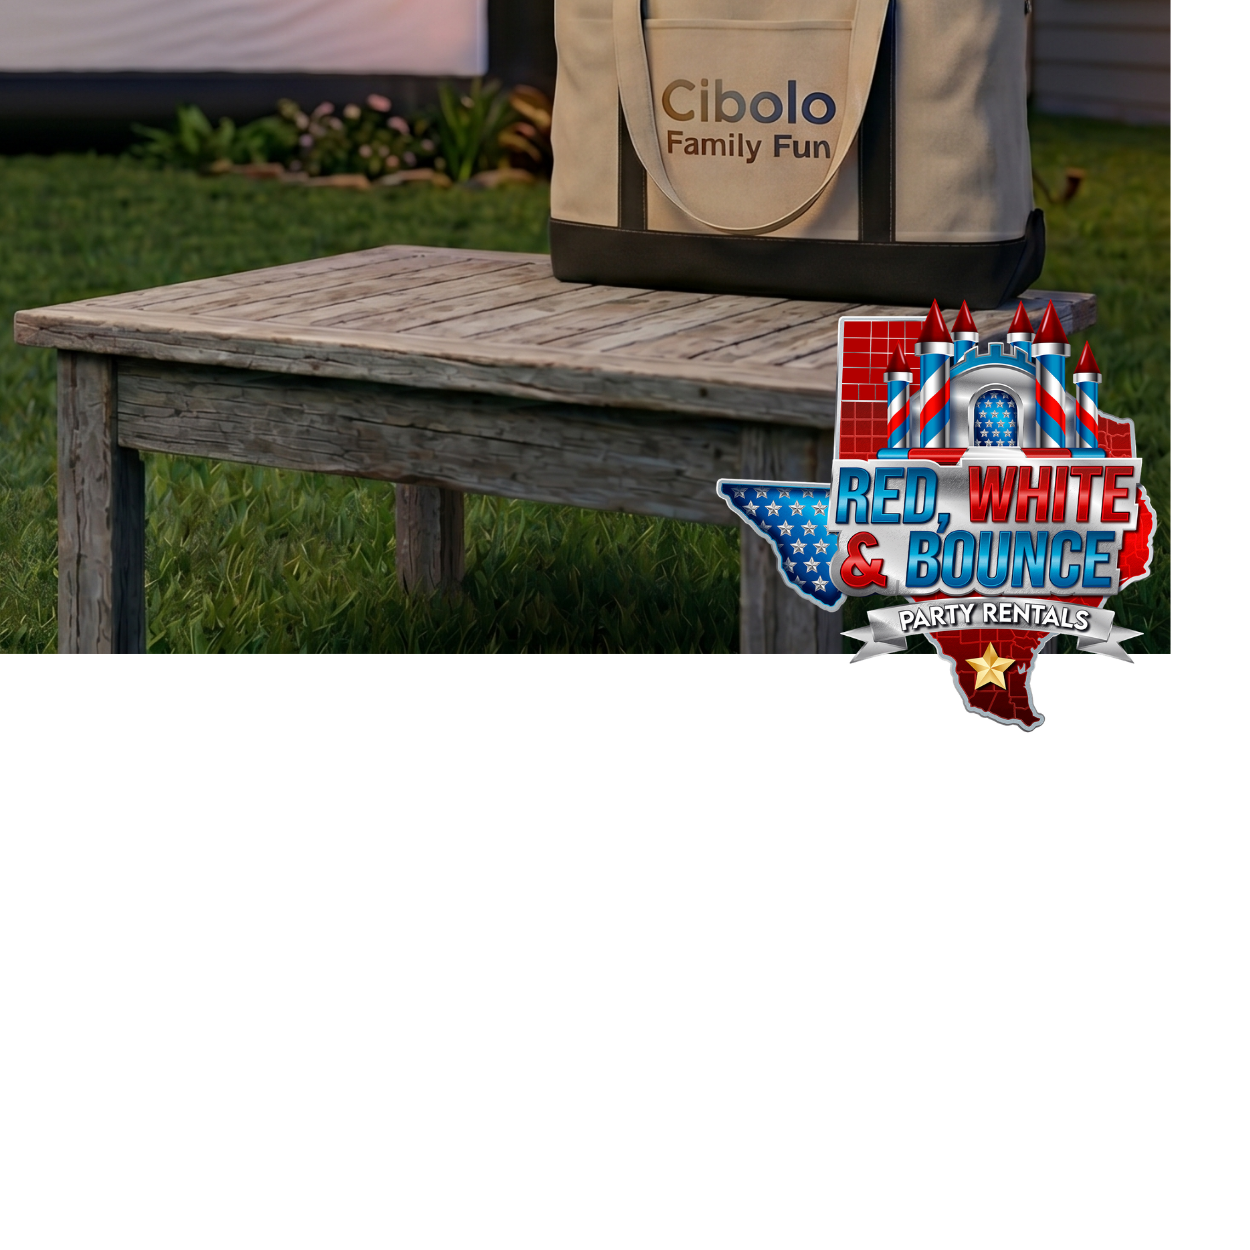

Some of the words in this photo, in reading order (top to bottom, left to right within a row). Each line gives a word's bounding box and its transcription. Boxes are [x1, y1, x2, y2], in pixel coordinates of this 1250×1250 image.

[661, 78, 837, 125] Cibolo
[666, 130, 762, 163] Family
[773, 134, 831, 159] Fun
